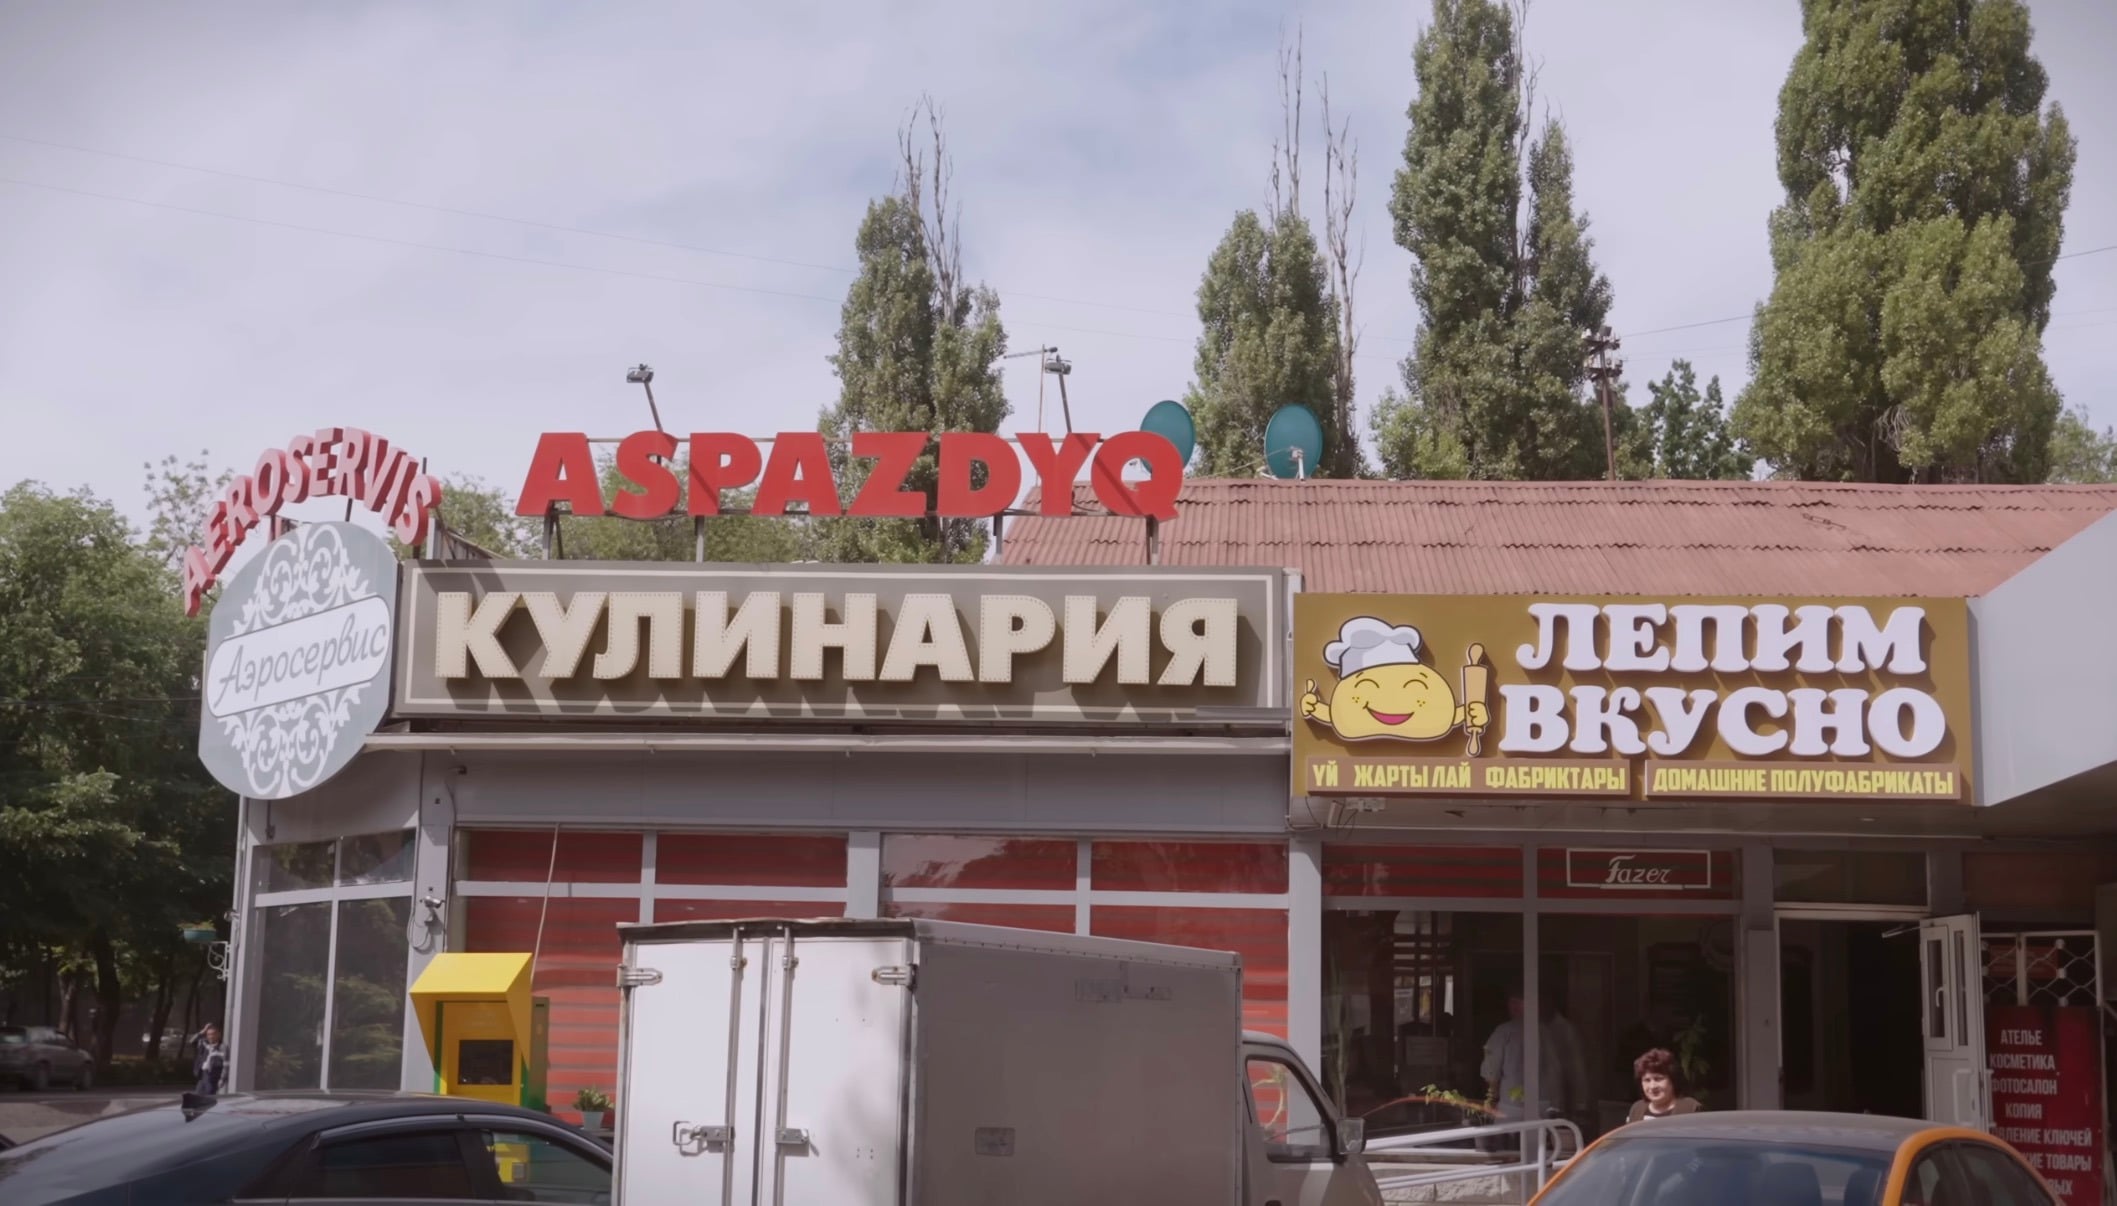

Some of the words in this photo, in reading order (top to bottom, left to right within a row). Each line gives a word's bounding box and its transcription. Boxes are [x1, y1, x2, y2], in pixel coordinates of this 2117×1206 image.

[515, 429, 1184, 522] ASPAZDYQ
[183, 426, 441, 618] AEROSERVIS
[435, 590, 1238, 688] КУЛИНАРИЯ
[1516, 603, 1926, 674] ЛЕПИМ
[213, 612, 387, 709] Аэросервис
[1499, 684, 1945, 757] ВКУСНО
[1485, 766, 1625, 790] ФАБРИКТАРЫ
[1652, 768, 1767, 793] ДОМАШНИЕ
[1770, 769, 1953, 794] ПОЛУФАБРИКАТЫ
[1605, 854, 1672, 883] Fazer
[2000, 1029, 2042, 1046] АТЕЛЬЕ
[1990, 1053, 2056, 1070] КОСМЕТИКА
[1992, 1078, 2058, 1095] ФОТОСАЛОН
[2005, 1103, 2042, 1119] КОПИЯ
[2043, 1128, 2092, 1147] КЛЮЧЕЙ
[2046, 1152, 2092, 1172] ТОВАРЫ
